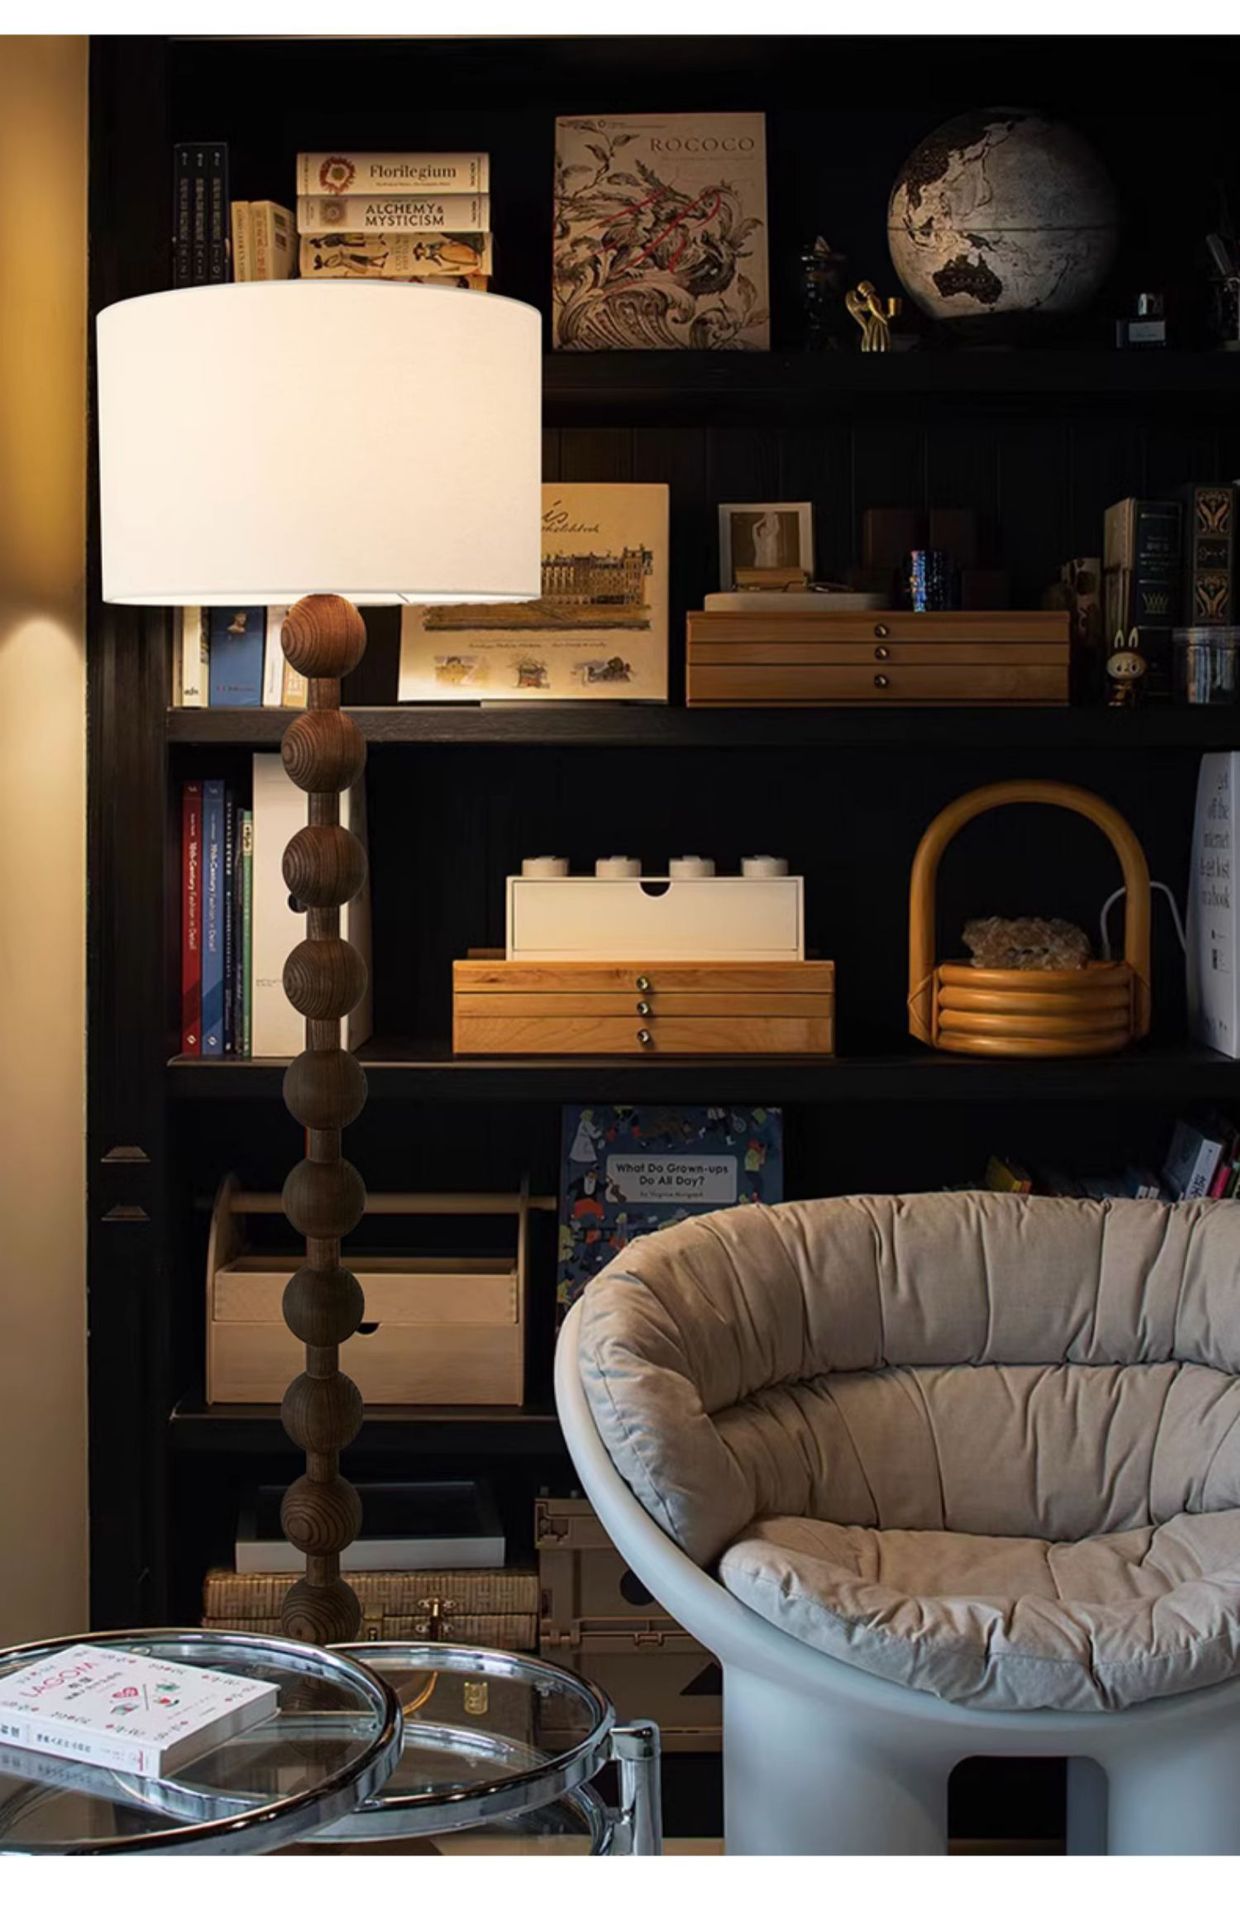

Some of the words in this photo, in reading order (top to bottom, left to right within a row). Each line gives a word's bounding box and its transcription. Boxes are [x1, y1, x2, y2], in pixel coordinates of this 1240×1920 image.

[650, 136, 755, 152] ROCOCO
[369, 164, 457, 181] Florilegium
[366, 203, 435, 214] ALCHEMY
[365, 215, 445, 227] MYSTICISM
[616, 1163, 645, 1173] What
[648, 1163, 663, 1173] Do
[666, 1163, 729, 1175] Grown-ups
[639, 1176, 655, 1186] Do
[658, 1175, 673, 1186] All
[676, 1176, 705, 1187] Day?
